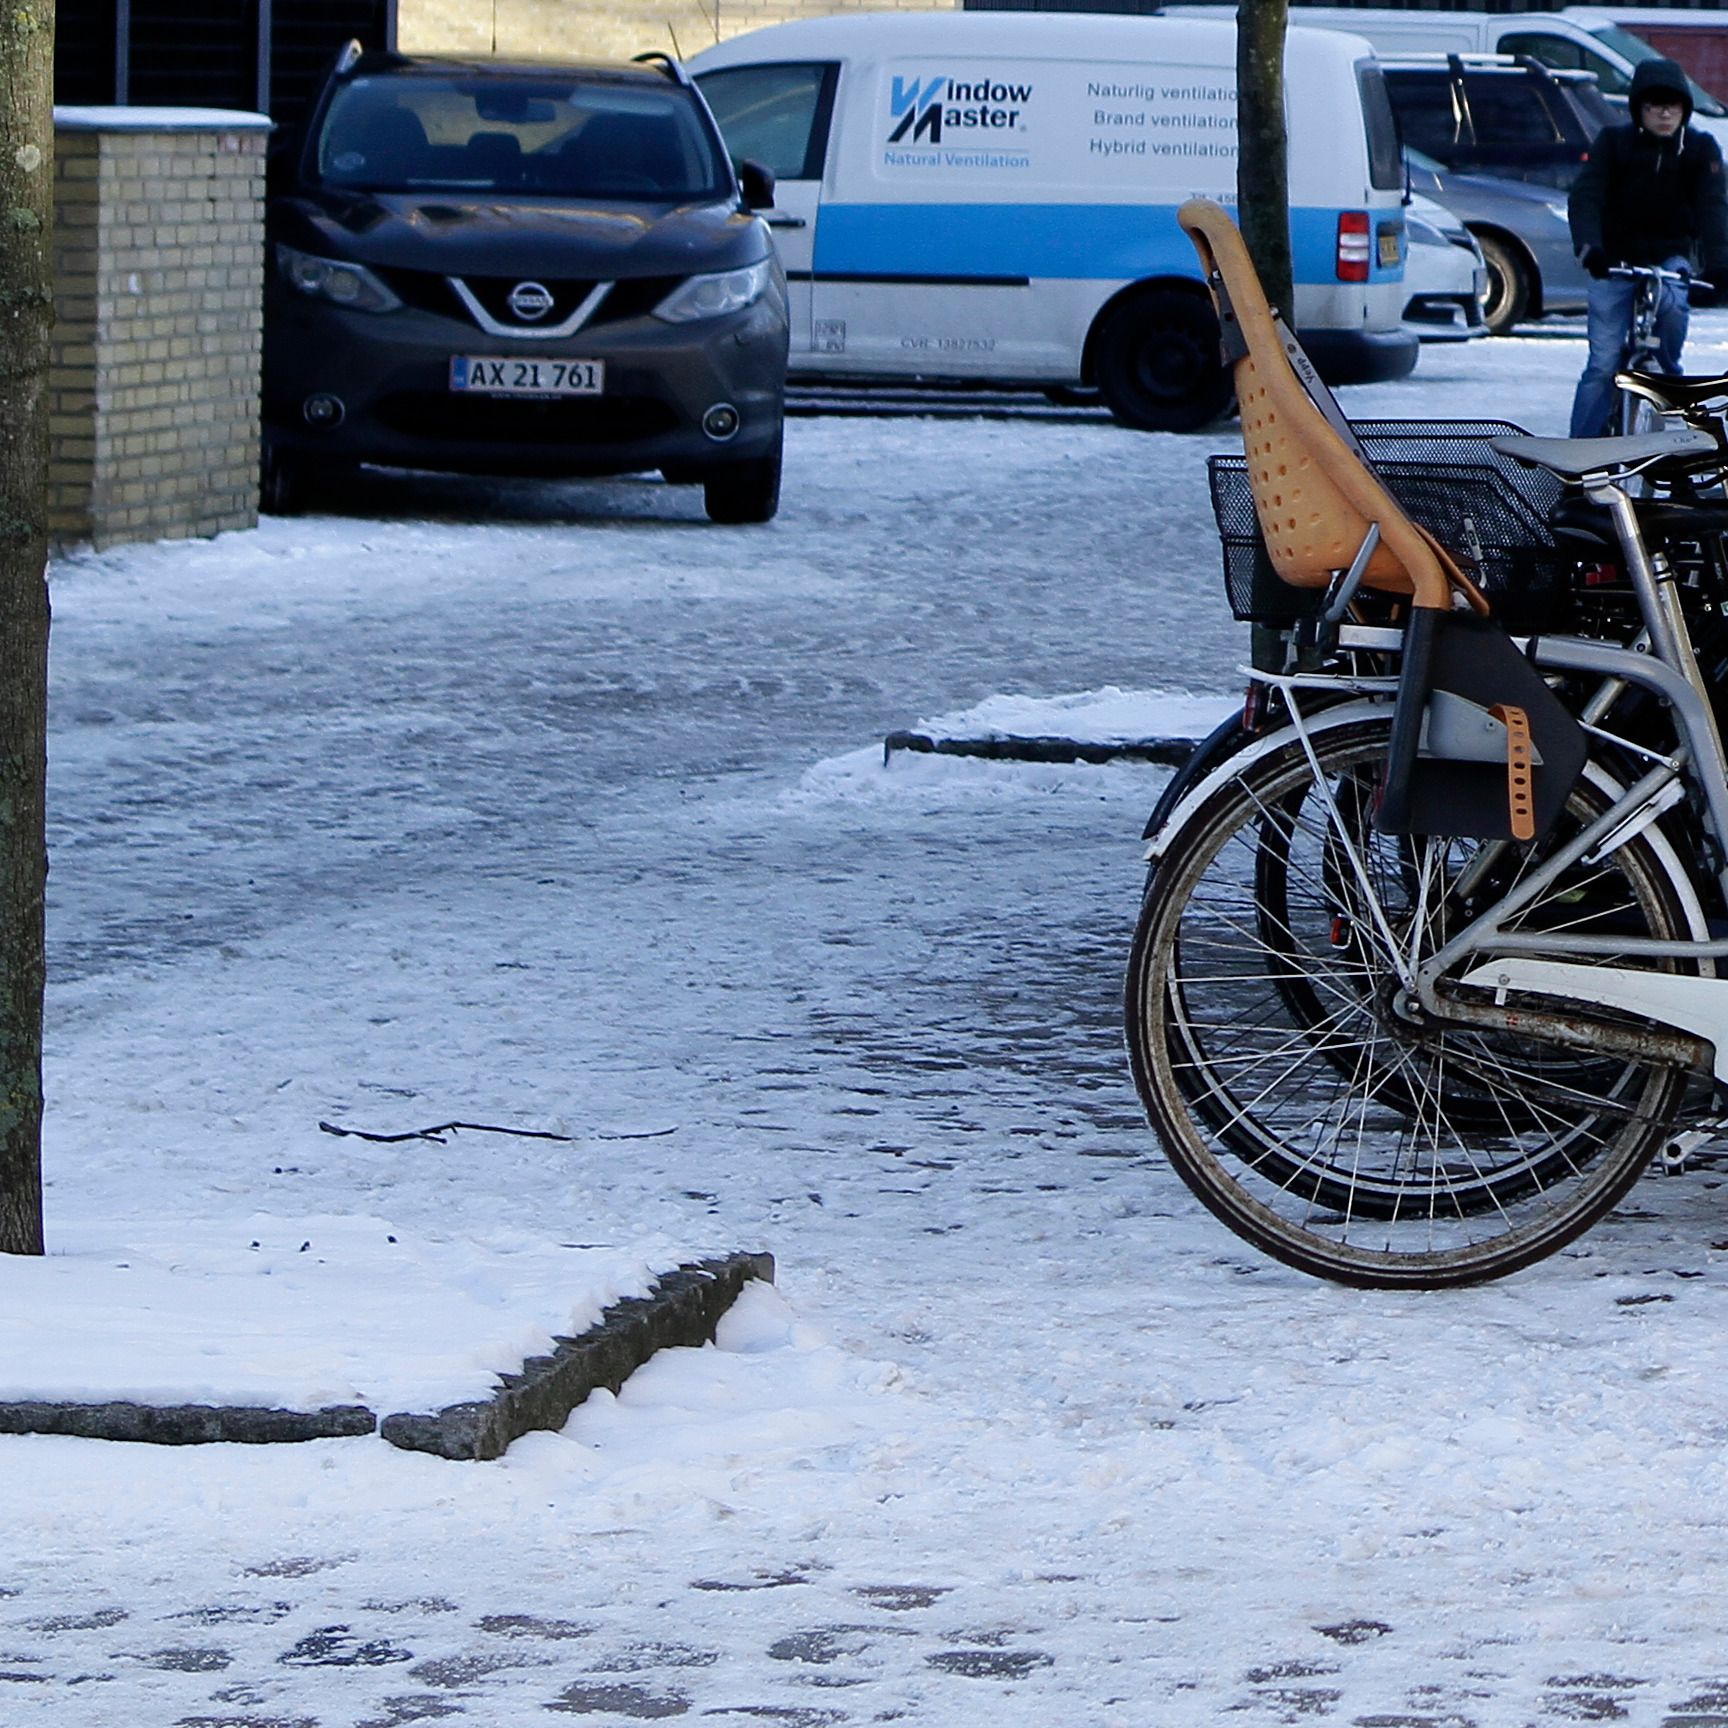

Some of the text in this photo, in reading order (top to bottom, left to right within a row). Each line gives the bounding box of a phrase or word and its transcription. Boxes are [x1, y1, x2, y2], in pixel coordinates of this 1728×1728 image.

[1087, 82, 1238, 101] Naturlig ventilatio
[887, 103, 1020, 144] Master
[1093, 109, 1145, 125] Brand
[1090, 138, 1146, 157] Hybrid
[884, 151, 1030, 168] Natural Ventilation
[470, 362, 596, 389] AX 21 761
